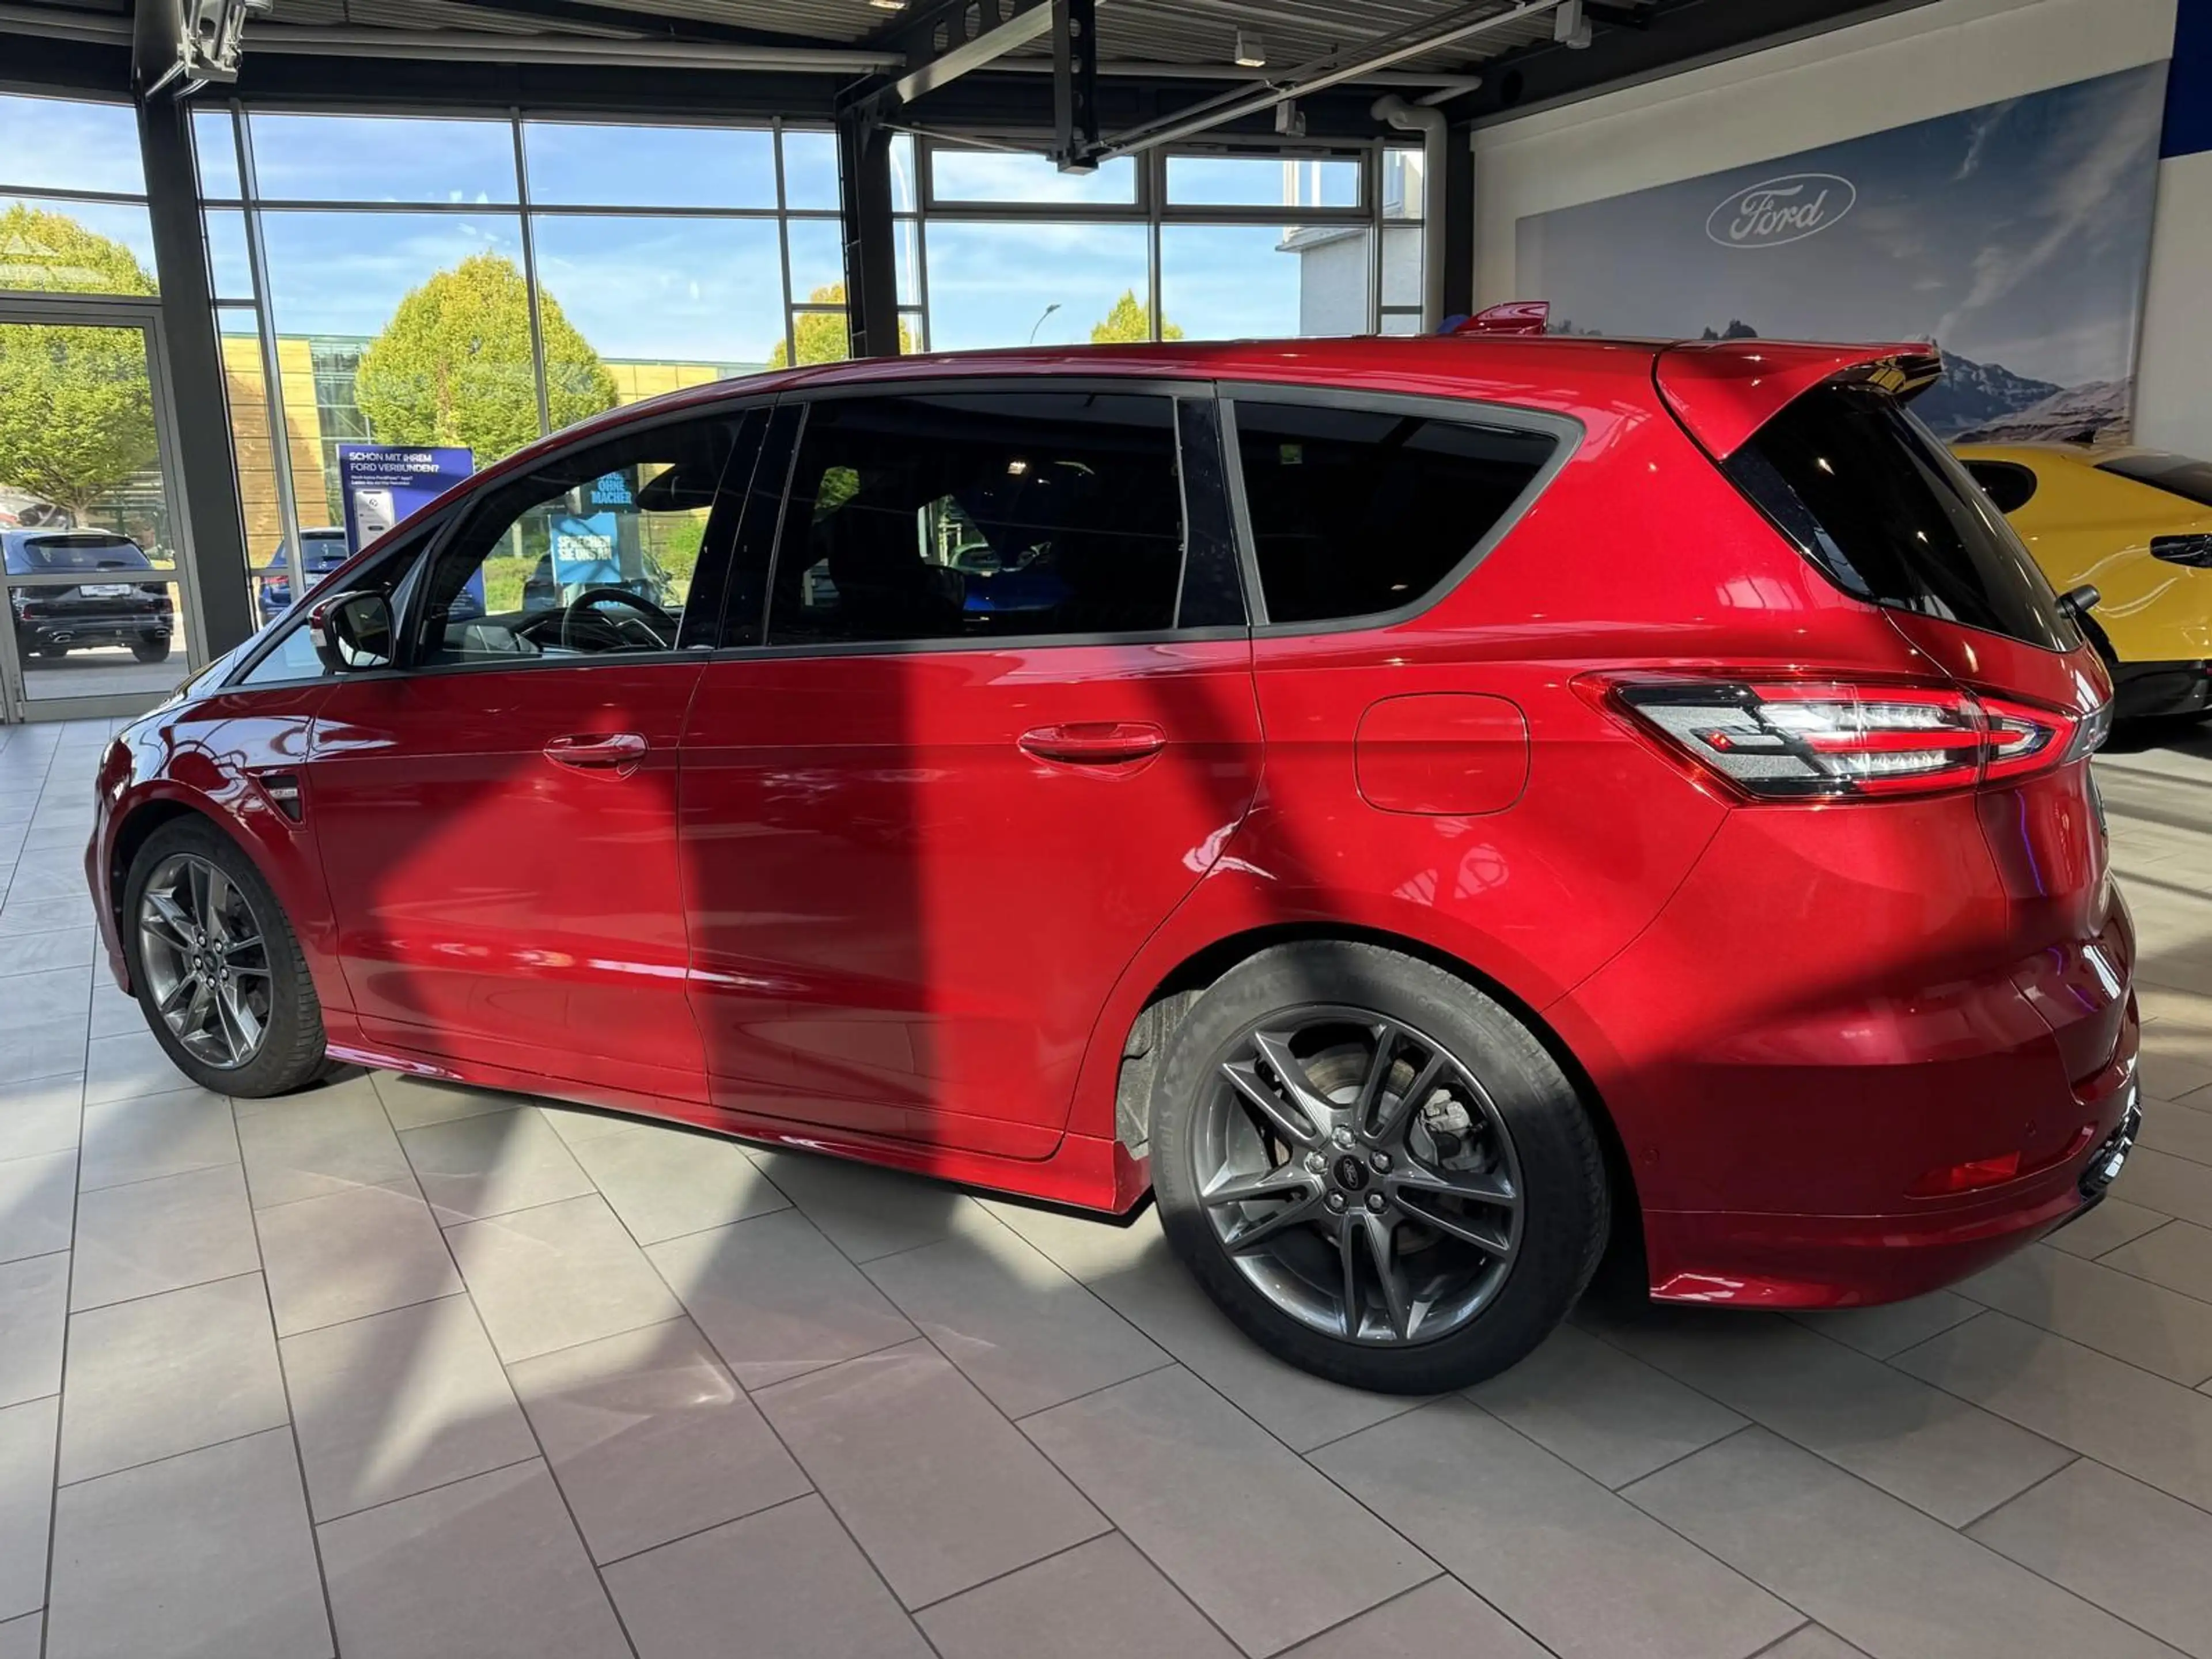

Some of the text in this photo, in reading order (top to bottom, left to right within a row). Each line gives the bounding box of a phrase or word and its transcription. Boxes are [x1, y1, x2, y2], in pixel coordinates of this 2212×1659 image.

[1730, 184, 1828, 240] Ford
[349, 452, 383, 461] SCHON
[403, 453, 432, 462] IHREM
[350, 463, 439, 472] FORD VERBUNDEN?
[591, 491, 632, 503] MACHER
[558, 548, 575, 560] SIE
